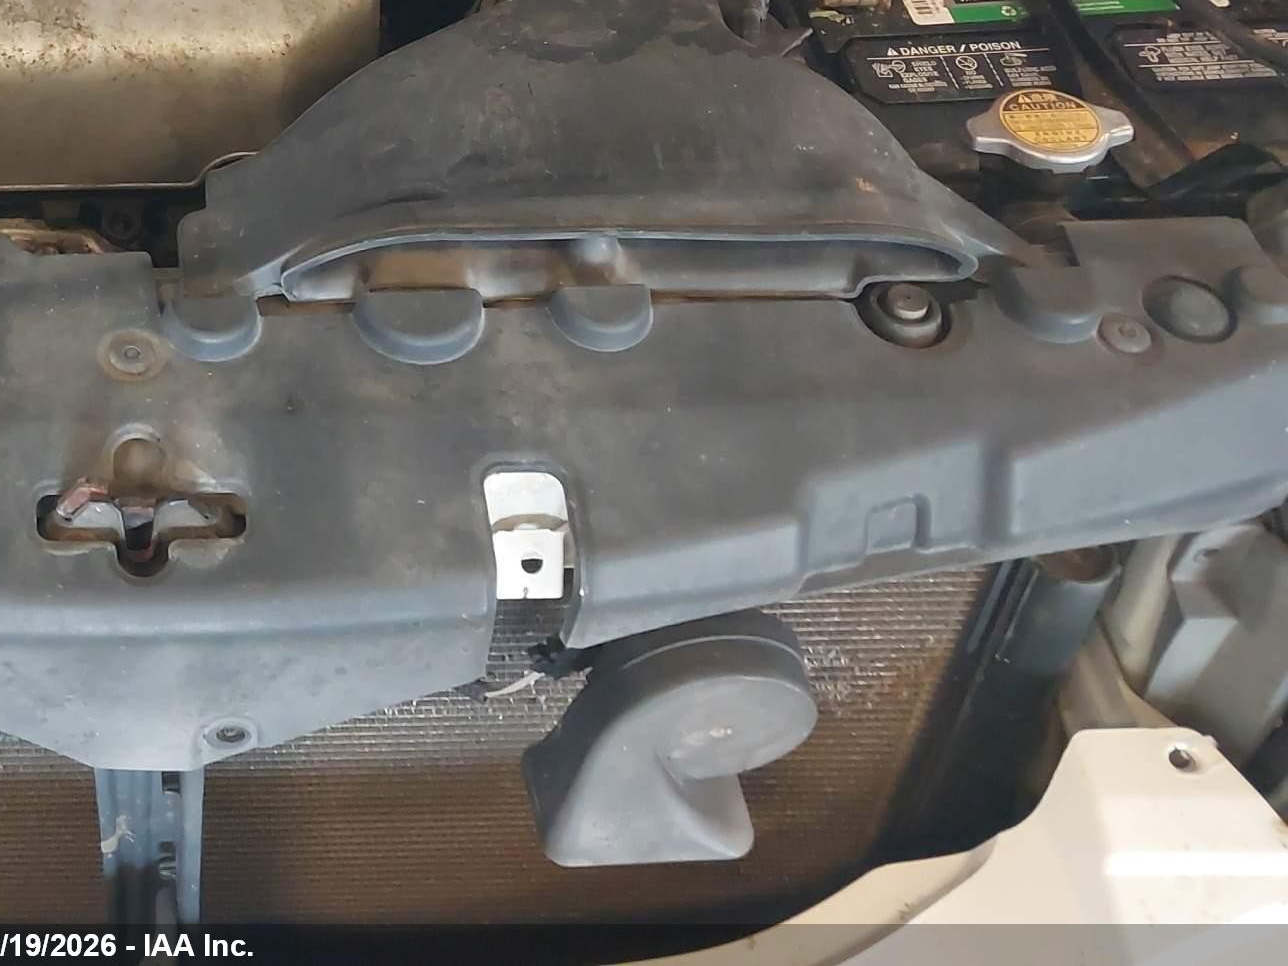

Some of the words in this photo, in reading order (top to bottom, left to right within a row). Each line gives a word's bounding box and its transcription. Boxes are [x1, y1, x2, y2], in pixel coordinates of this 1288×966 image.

[899, 45, 956, 56] DANGER
[968, 41, 1022, 52] POISON
[1008, 101, 1077, 112] CAUTION
